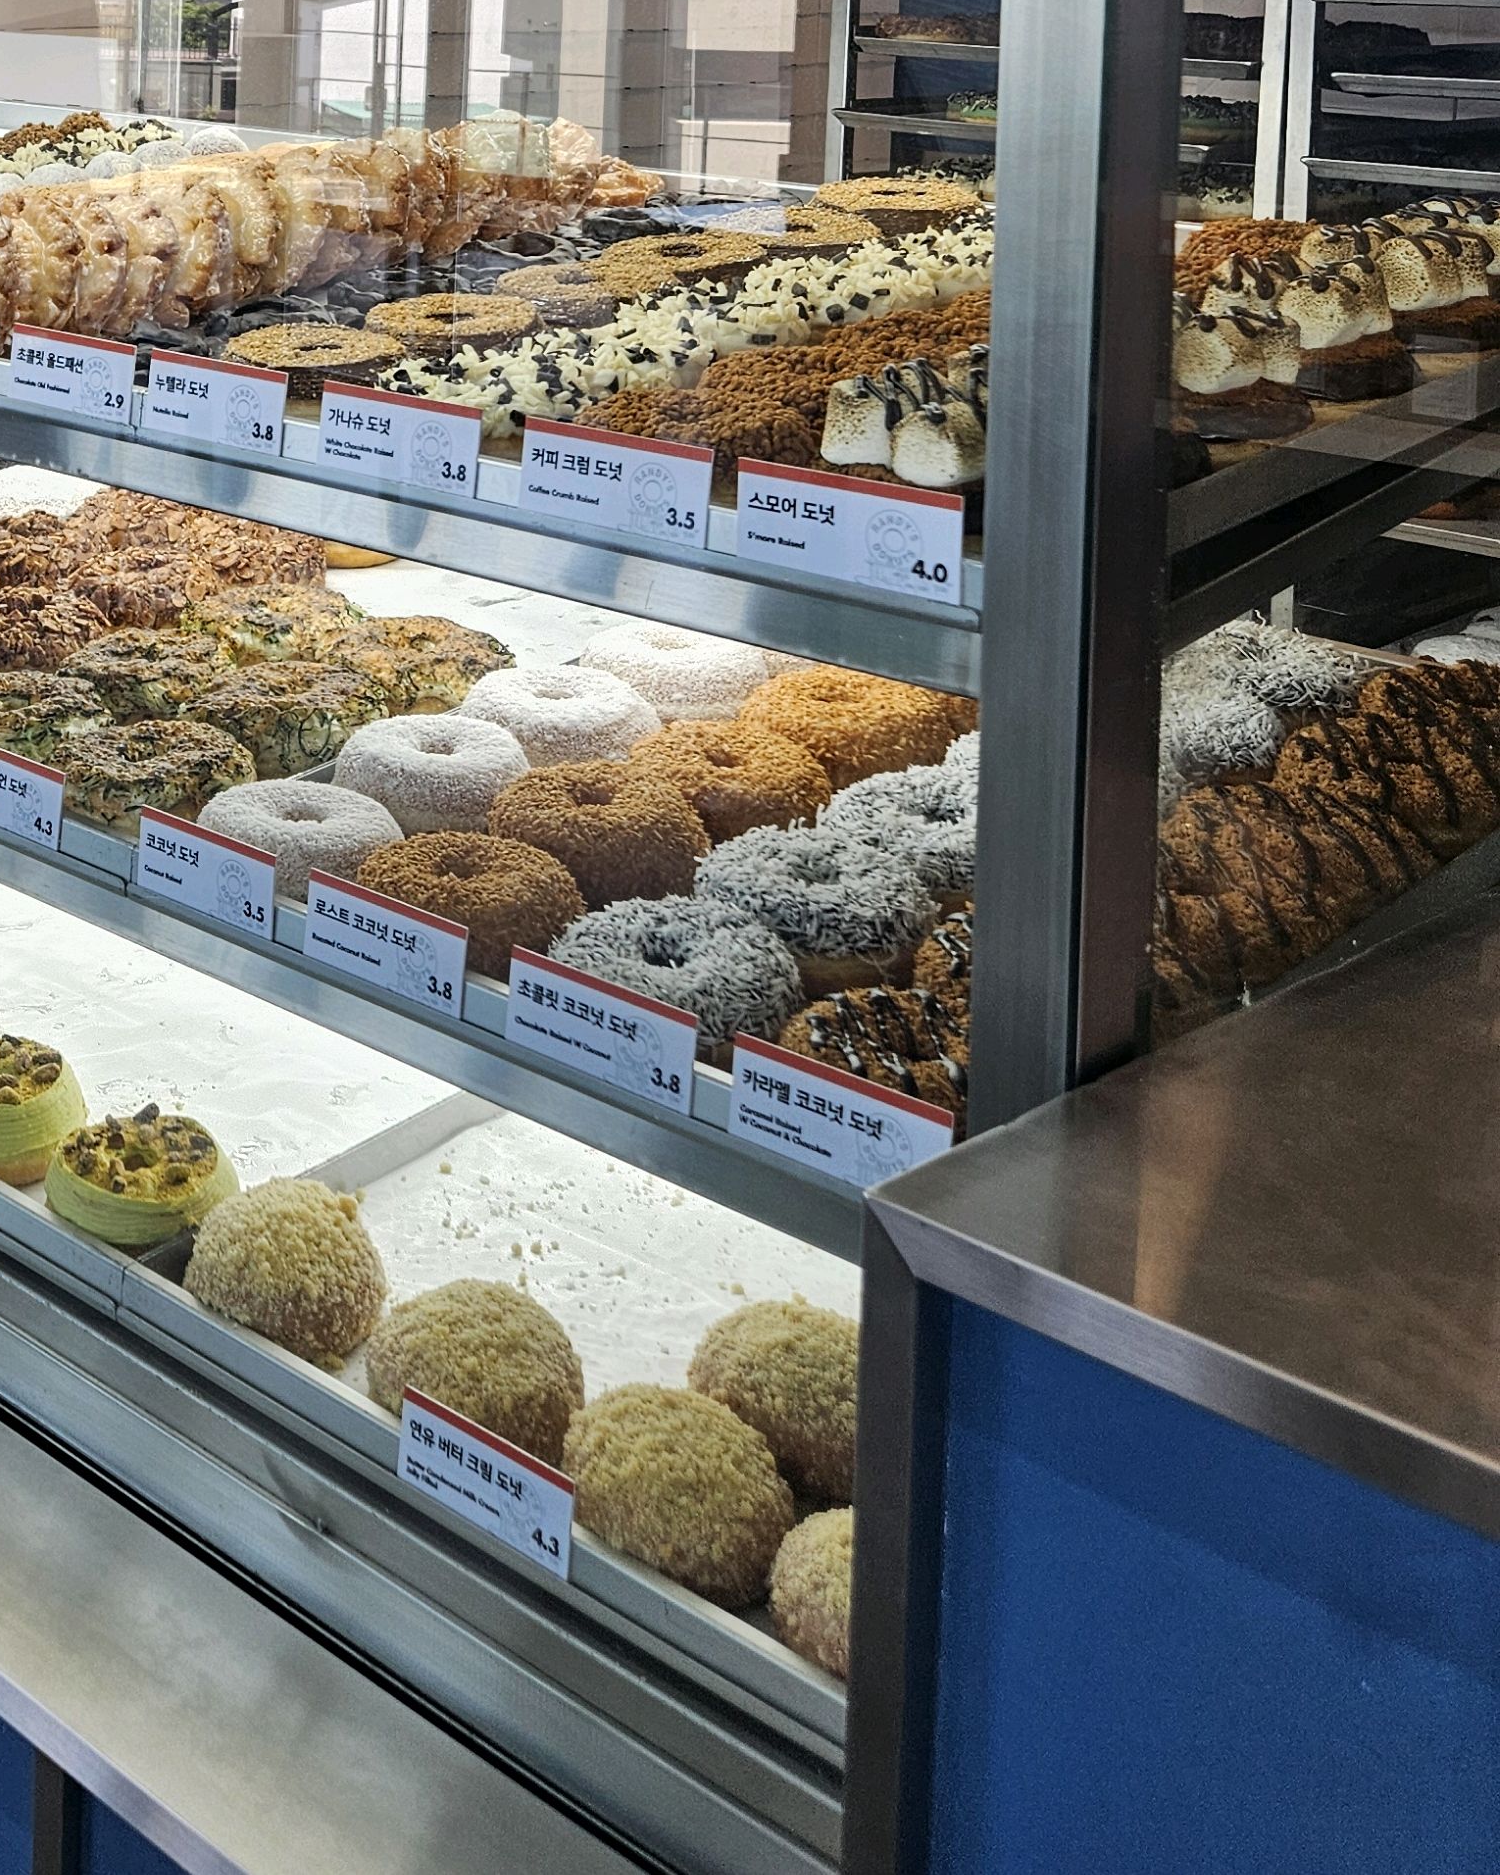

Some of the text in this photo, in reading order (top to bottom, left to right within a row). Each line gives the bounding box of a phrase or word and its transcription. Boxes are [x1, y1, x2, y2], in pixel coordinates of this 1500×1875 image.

[16, 346, 84, 375] 초콜릿 올드패션
[104, 391, 125, 409] 2.9
[155, 374, 209, 400] 누텔라 도넛
[251, 422, 274, 441] 3.8
[328, 408, 391, 436] 가나슈 도넛
[441, 461, 466, 482] 3.8
[531, 447, 623, 482] 커피 크럼 도넛
[528, 485, 600, 506] Coffee Crumb Raised
[666, 507, 695, 531] 3.5
[747, 492, 835, 527] 스모어 도넛
[747, 530, 776, 544] S'more
[911, 559, 948, 583] 4.0
[8, 778, 28, 799] 도넛
[33, 816, 53, 836] 4.3
[145, 832, 199, 868] 코코넛 도넛
[242, 900, 265, 923] 3.5
[313, 898, 416, 954] 로스트 코코넛 도넛
[427, 975, 453, 1001] 3.8
[517, 978, 638, 1043] 초콜릿 코코넛 도넛
[650, 1067, 682, 1095] 3.8
[742, 1068, 883, 1141] 카라멜 코코넛 도넛
[409, 1419, 523, 1502] 연유 버터 크림 도넛
[531, 1527, 560, 1558] 4.3
